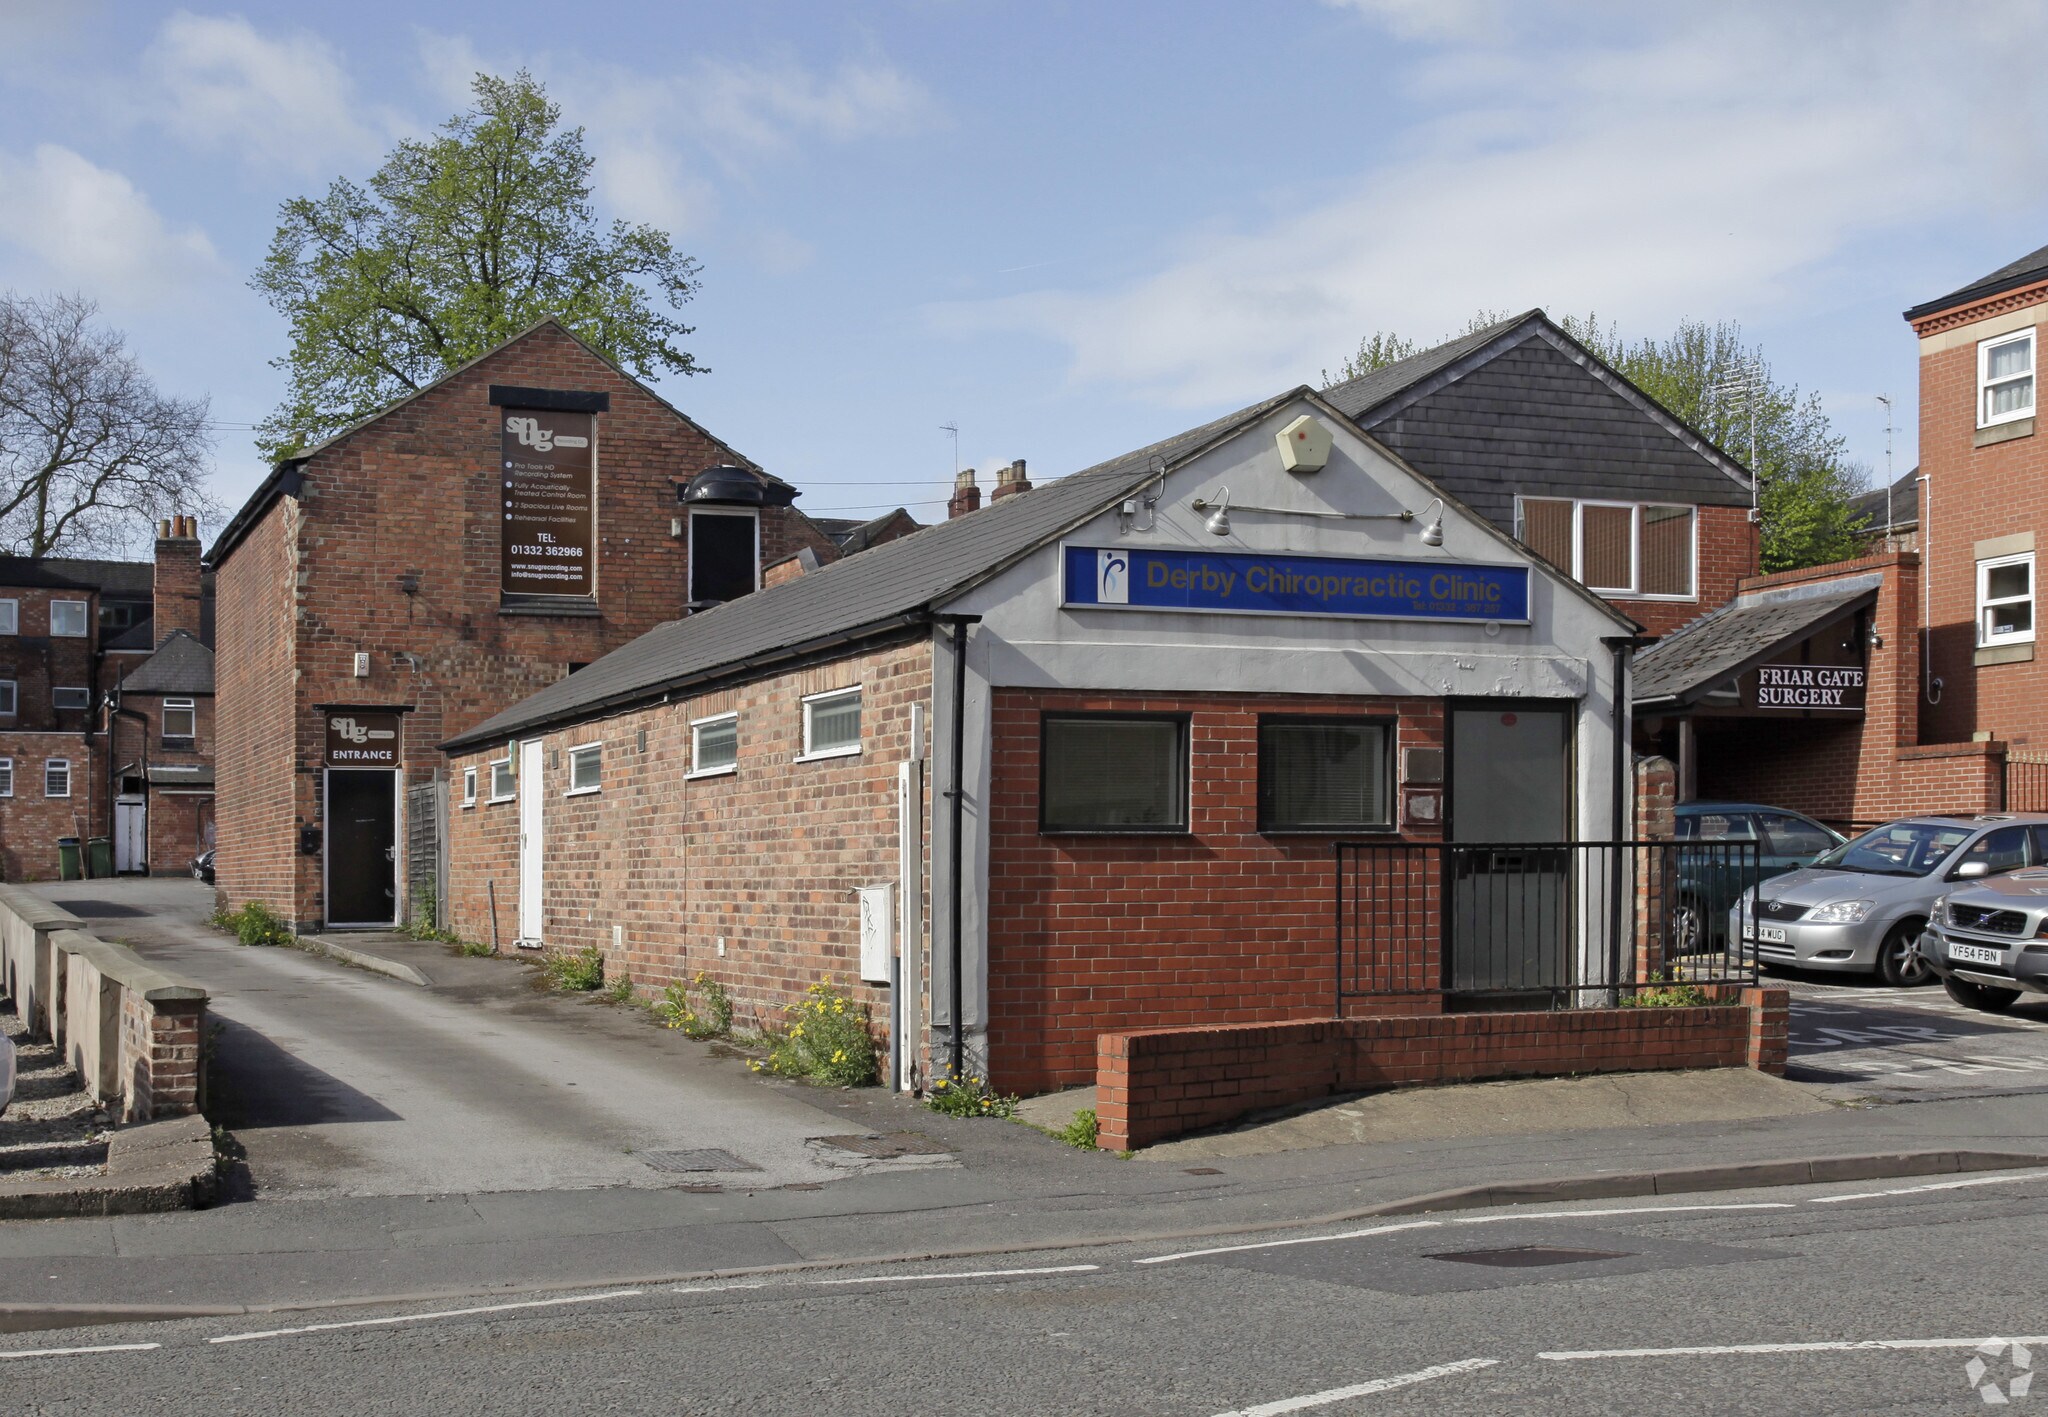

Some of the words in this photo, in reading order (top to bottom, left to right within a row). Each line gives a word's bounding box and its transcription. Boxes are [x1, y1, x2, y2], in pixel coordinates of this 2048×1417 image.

[514, 470, 549, 479] Recording
[530, 484, 571, 492] Acoustically
[537, 533, 556, 543] TEL:
[511, 545, 543, 555] 01332
[545, 546, 583, 557] 362966
[511, 564, 583, 573] www.snugrecording.com
[511, 571, 583, 581] info@snugrecording.com
[1147, 560, 1236, 597] Derby
[1246, 566, 1421, 601] Chiropractic
[1430, 574, 1501, 602] Clinic
[1759, 669, 1814, 686] FRIAR
[1817, 671, 1864, 687] GATE
[1758, 688, 1844, 705] SURGERY
[333, 750, 392, 760] ENTRANCE
[1767, 928, 1782, 940] WUG
[1951, 947, 1975, 959] YF54
[1978, 949, 1998, 962] FBN
